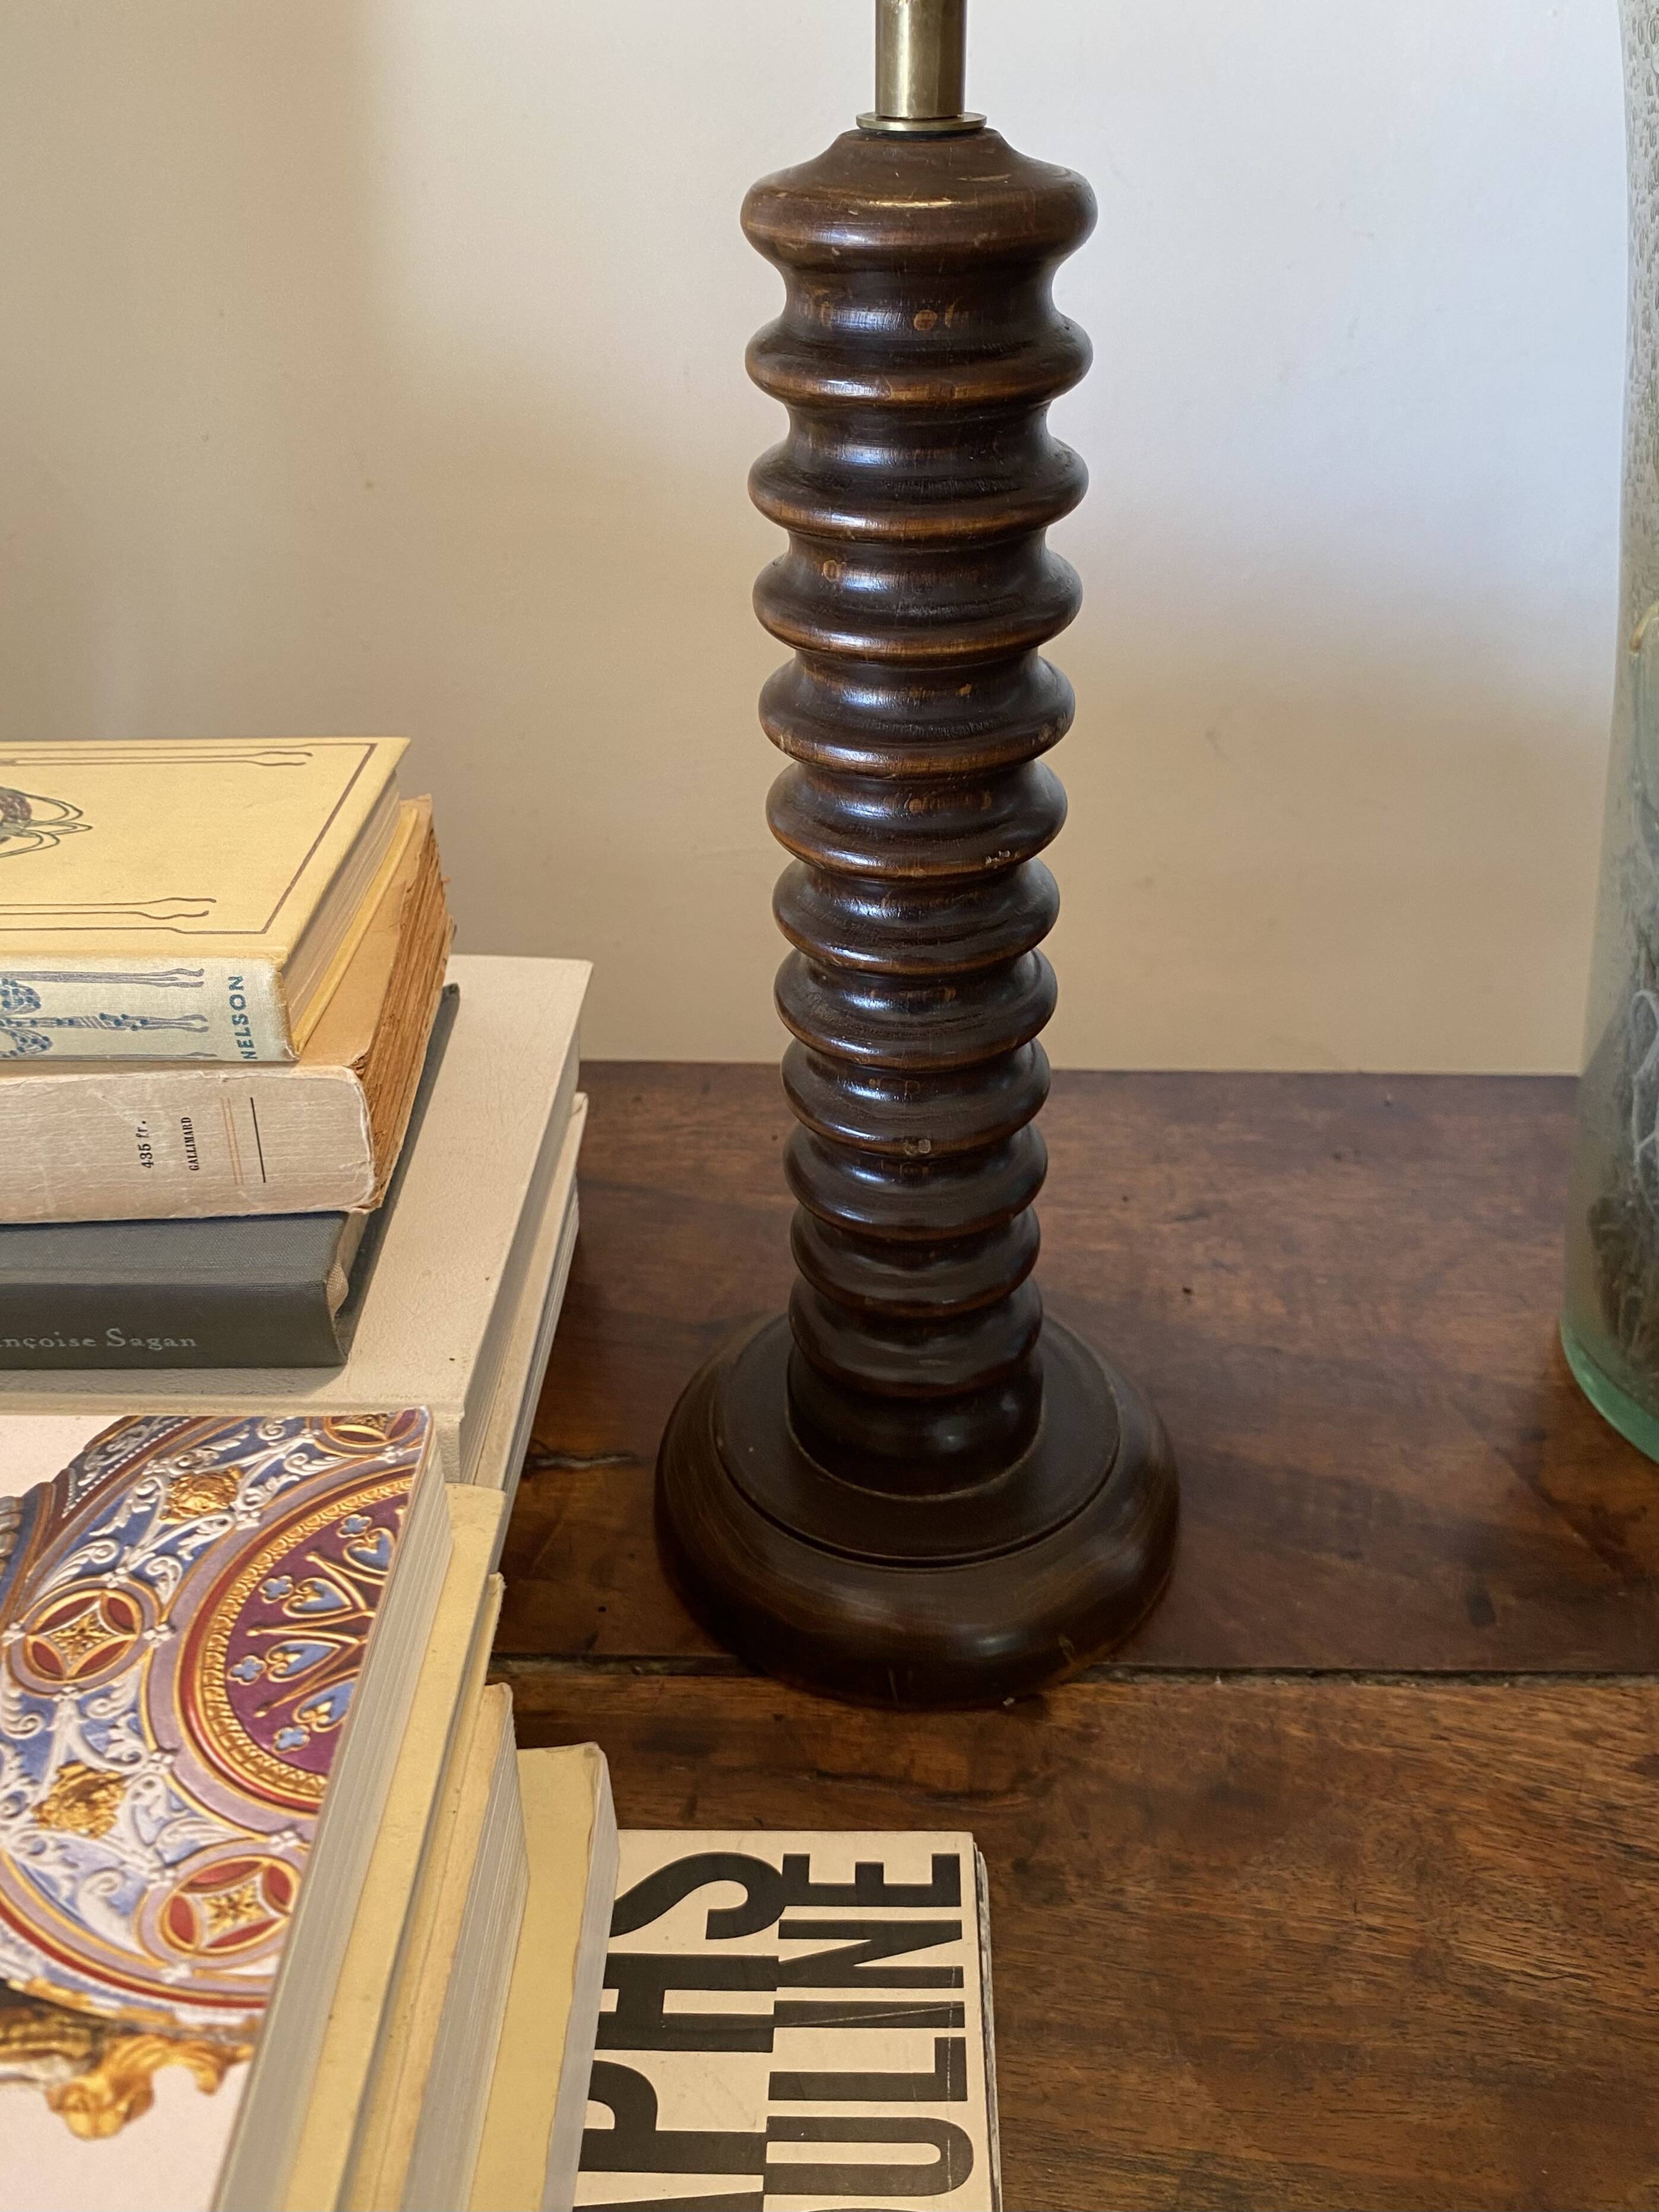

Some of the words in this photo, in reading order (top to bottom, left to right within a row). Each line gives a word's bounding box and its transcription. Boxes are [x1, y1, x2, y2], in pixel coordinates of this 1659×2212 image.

[228, 975, 258, 1059] NELSON
[181, 1117, 200, 1170] GALLIMARD
[0, 1331, 97, 1349] nçoise
[106, 1328, 198, 1350] Sagan
[762, 1853, 975, 2212] ULINE
